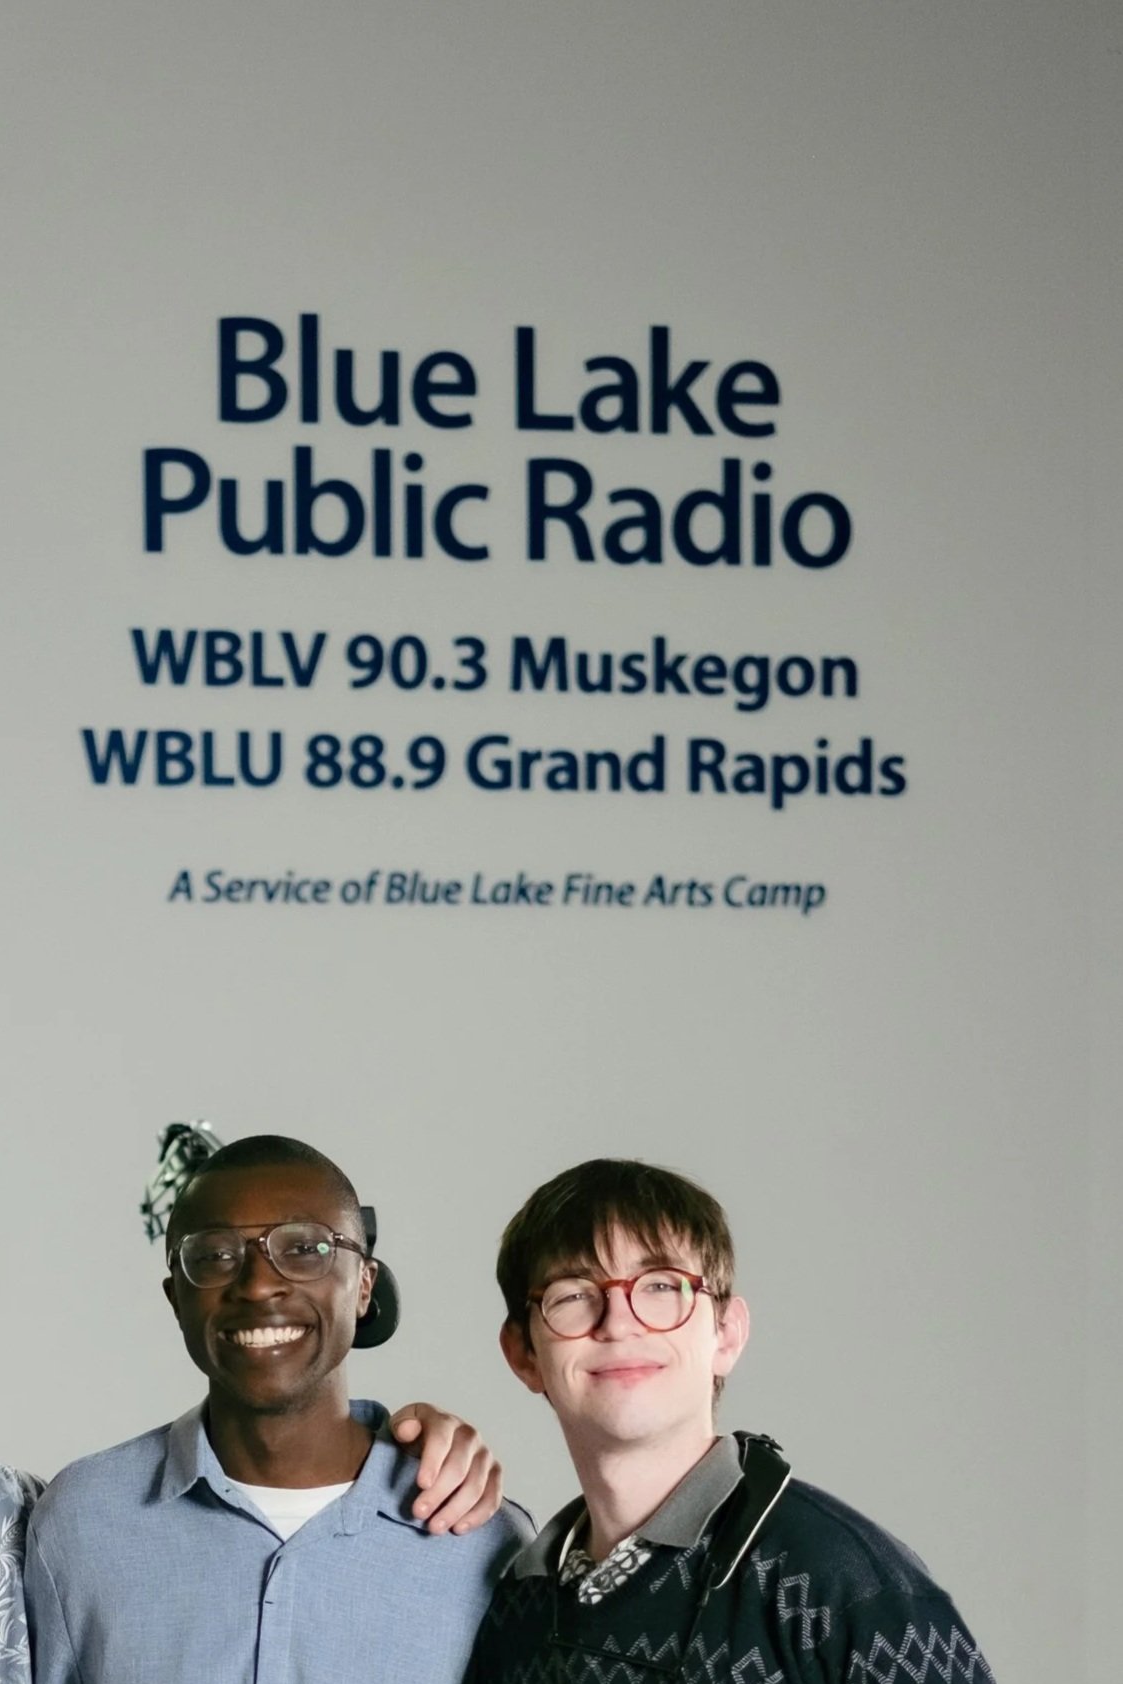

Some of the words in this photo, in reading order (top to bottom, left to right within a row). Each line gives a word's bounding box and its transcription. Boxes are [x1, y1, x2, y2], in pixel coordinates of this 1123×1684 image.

[216, 311, 480, 431] Blue
[513, 323, 784, 441] Lake
[141, 444, 492, 564] Public
[525, 455, 856, 572] Radio
[129, 627, 329, 689] WBLV
[344, 632, 489, 693] 90.3
[509, 634, 860, 715] Muskegon
[80, 727, 283, 789] WBLU
[303, 732, 448, 792] 88.9
[464, 732, 668, 795] Grand
[686, 735, 909, 813] Rapids
[168, 870, 193, 902] A
[203, 870, 332, 904] Service
[339, 869, 381, 905] of
[384, 871, 463, 906] Blue
[470, 872, 555, 906] Lake
[562, 872, 636, 908] Fine
[642, 874, 715, 908] Arts
[722, 874, 828, 917] Camp
